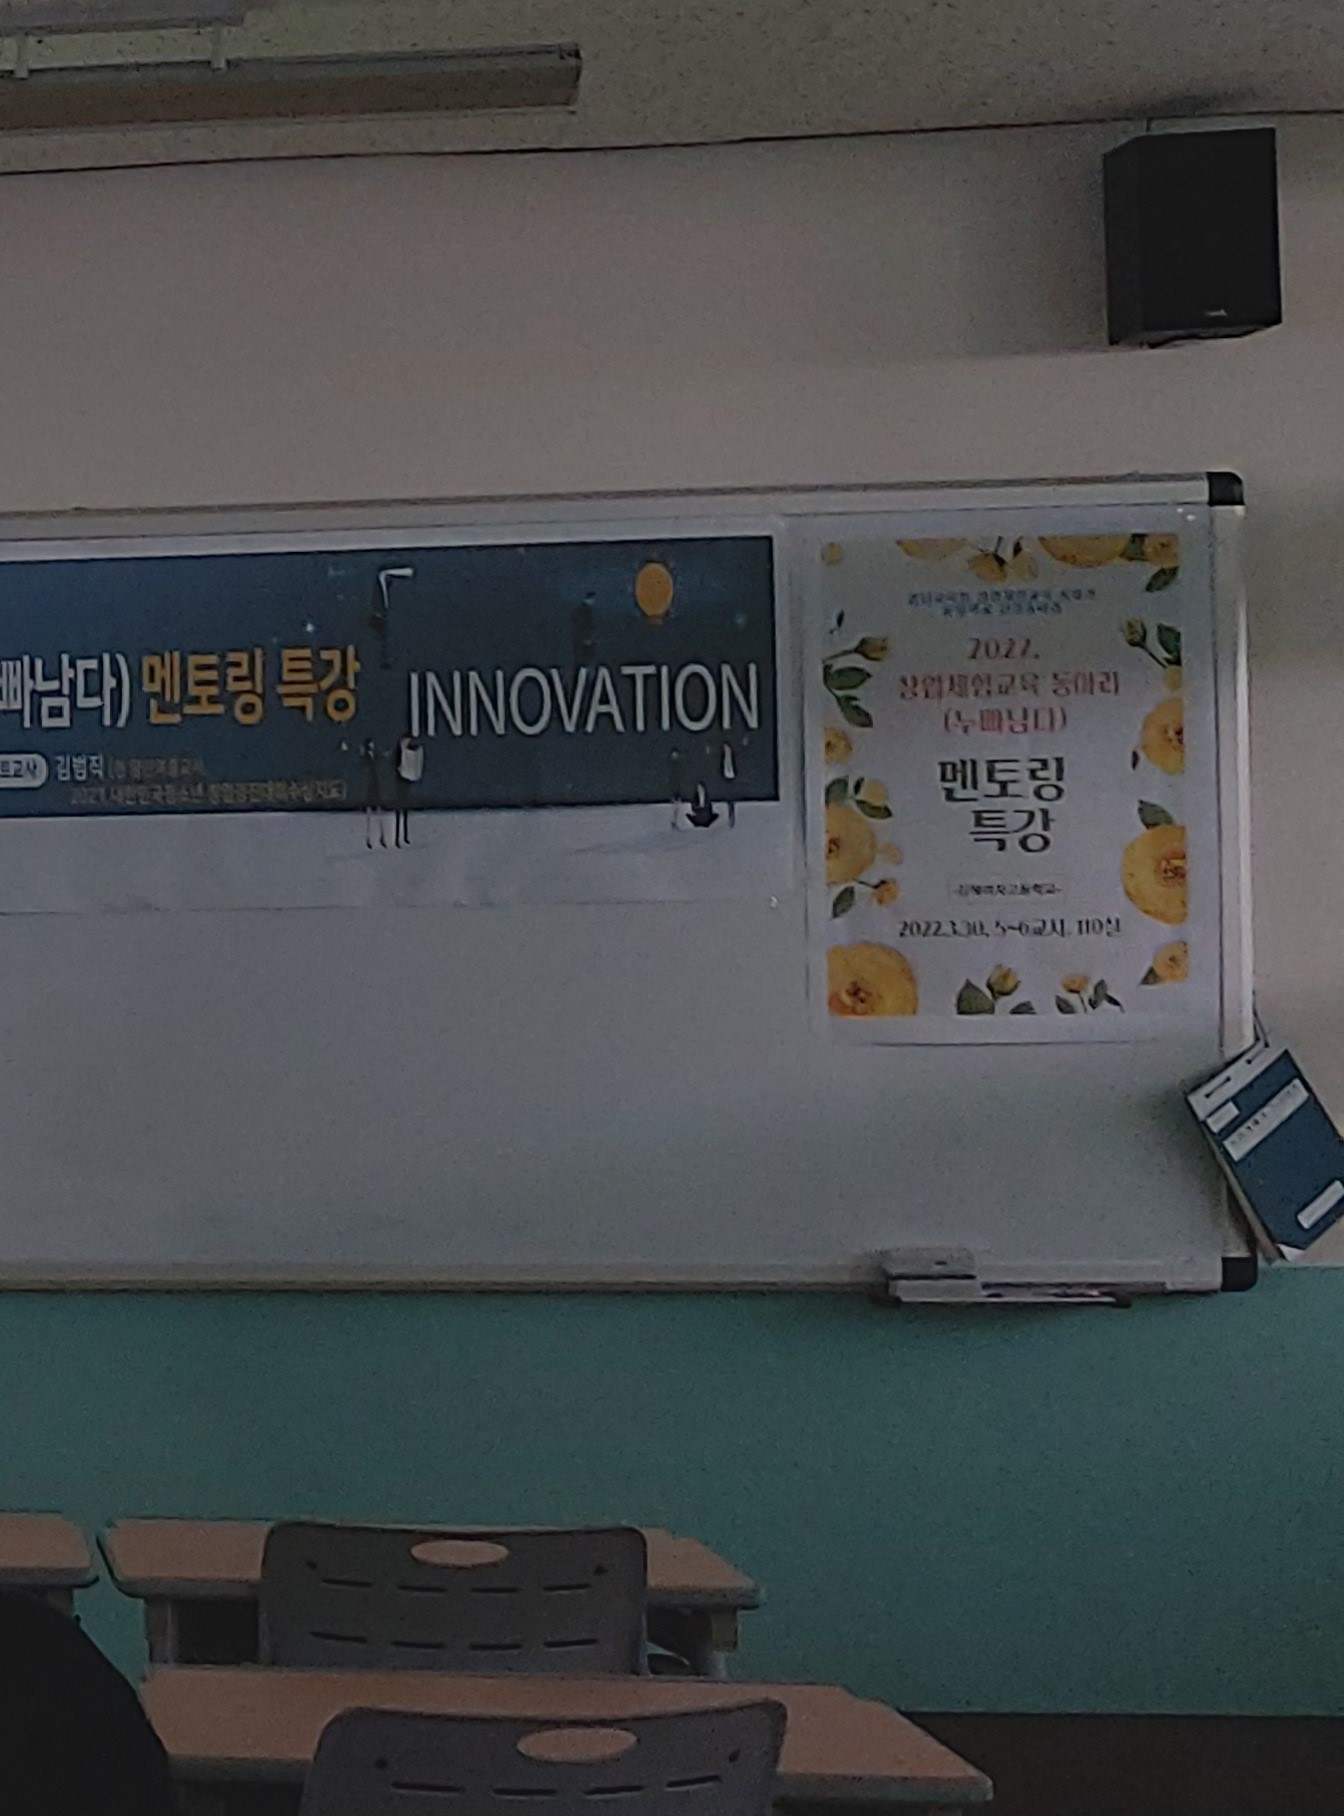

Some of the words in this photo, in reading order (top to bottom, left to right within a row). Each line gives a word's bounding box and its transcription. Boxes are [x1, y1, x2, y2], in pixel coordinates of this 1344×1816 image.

[142, 647, 263, 725] 멘토링
[276, 645, 361, 723] 특강
[409, 662, 759, 738] INNOVATION
[899, 672, 1039, 701] 창업체험교육
[1052, 671, 1120, 697] 동아리
[939, 756, 1064, 802] 멘토링
[969, 807, 1055, 853] 특강
